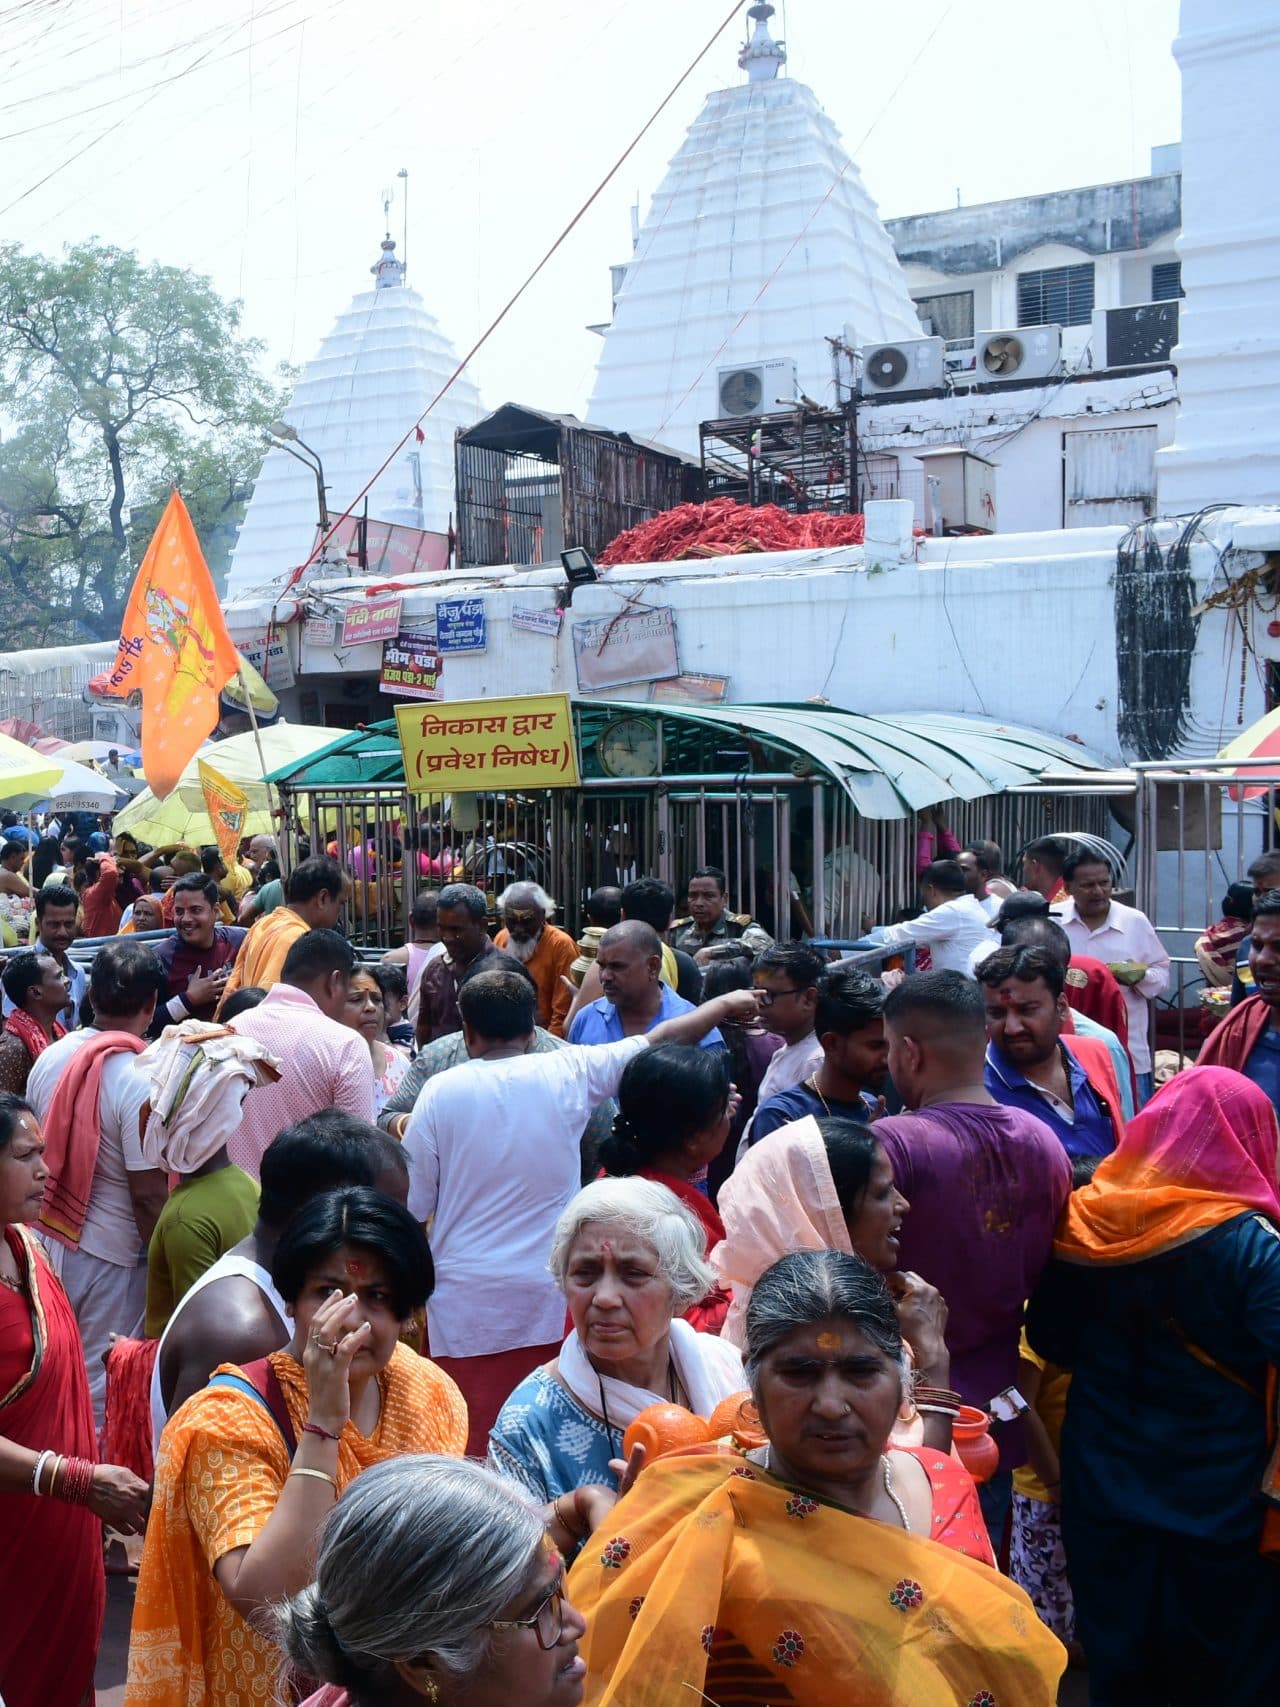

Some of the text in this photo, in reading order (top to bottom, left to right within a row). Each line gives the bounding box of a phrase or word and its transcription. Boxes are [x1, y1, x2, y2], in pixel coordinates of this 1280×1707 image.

[385, 648, 410, 665] भीम
[421, 713, 556, 737] निकास द्वार
[416, 741, 570, 778] (प्रवेश निषेध)
